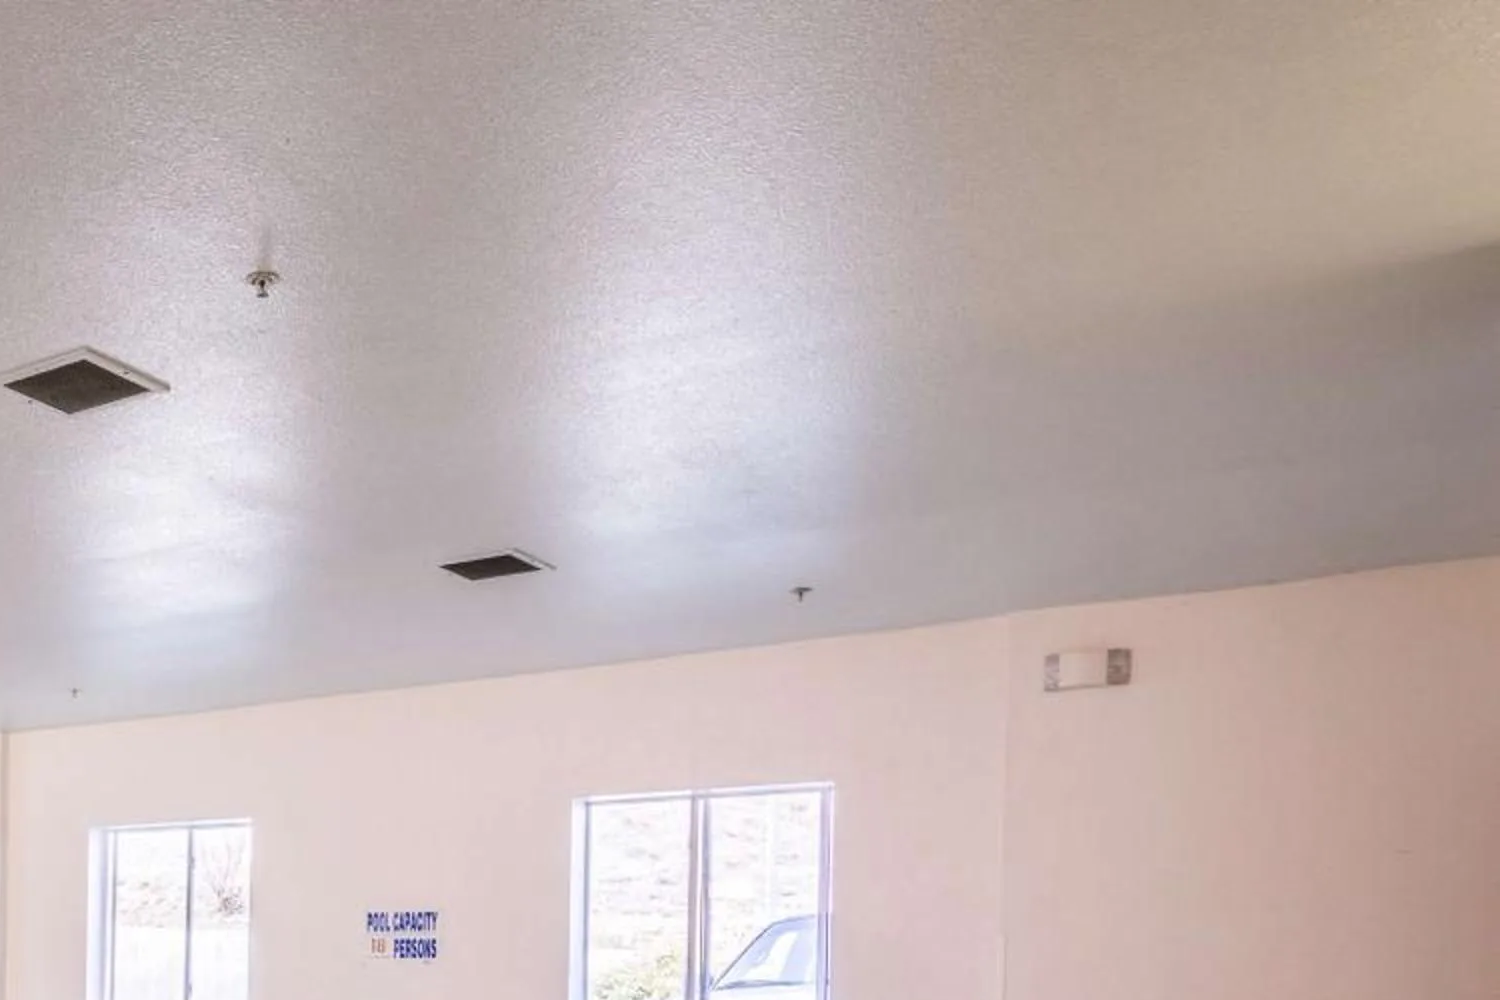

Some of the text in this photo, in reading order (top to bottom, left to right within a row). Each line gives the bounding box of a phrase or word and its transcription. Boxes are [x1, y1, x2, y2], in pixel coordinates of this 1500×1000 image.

[367, 911, 438, 932] POOL CAPACITY
[393, 938, 437, 959] PERSONS
